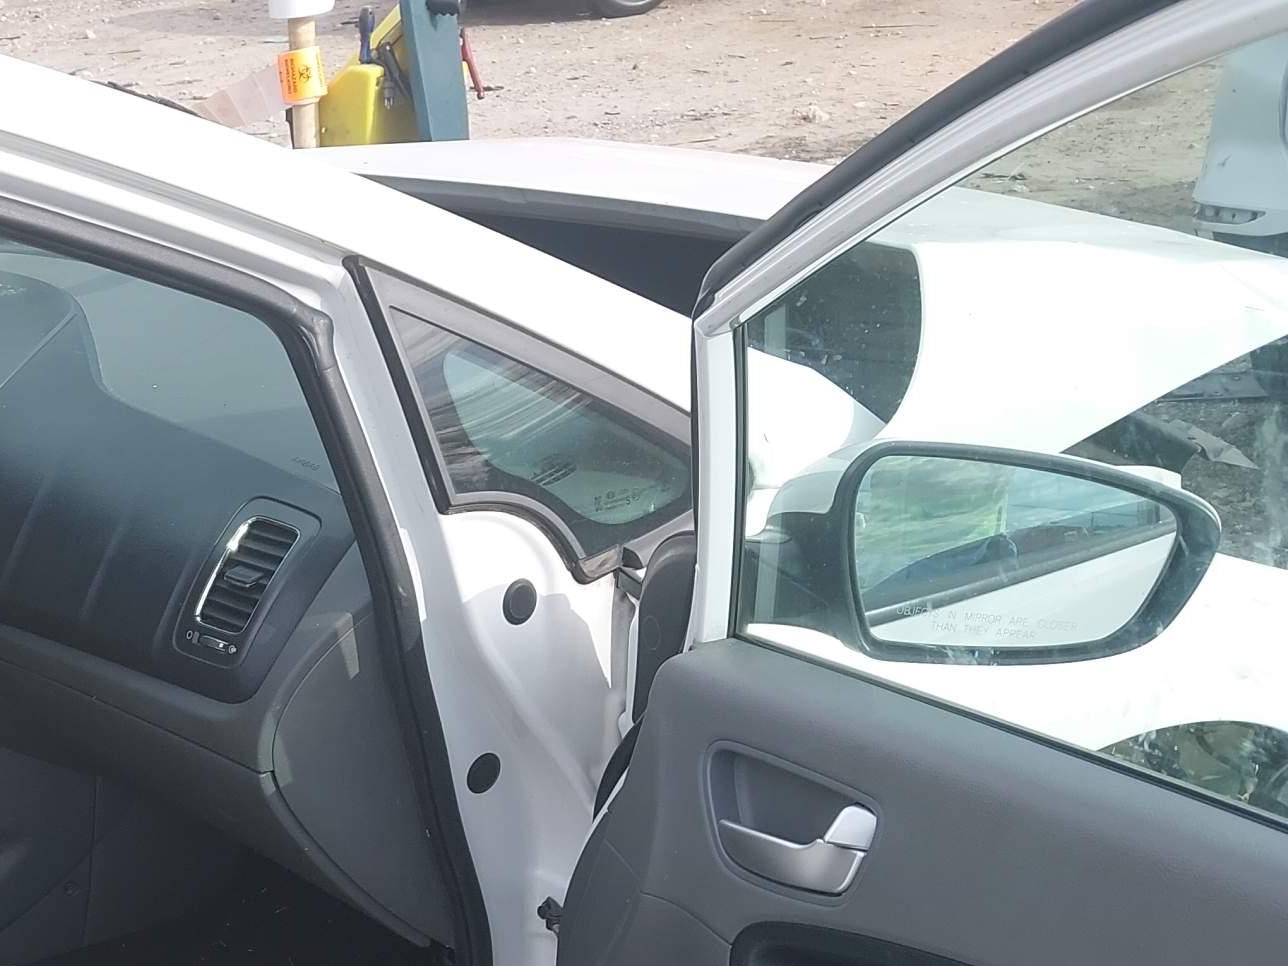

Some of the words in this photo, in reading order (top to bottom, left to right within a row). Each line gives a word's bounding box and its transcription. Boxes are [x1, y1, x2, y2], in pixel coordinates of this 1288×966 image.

[896, 605, 943, 618] OBJECS
[964, 611, 1002, 624] MIRROR
[1009, 615, 1031, 627] ARE
